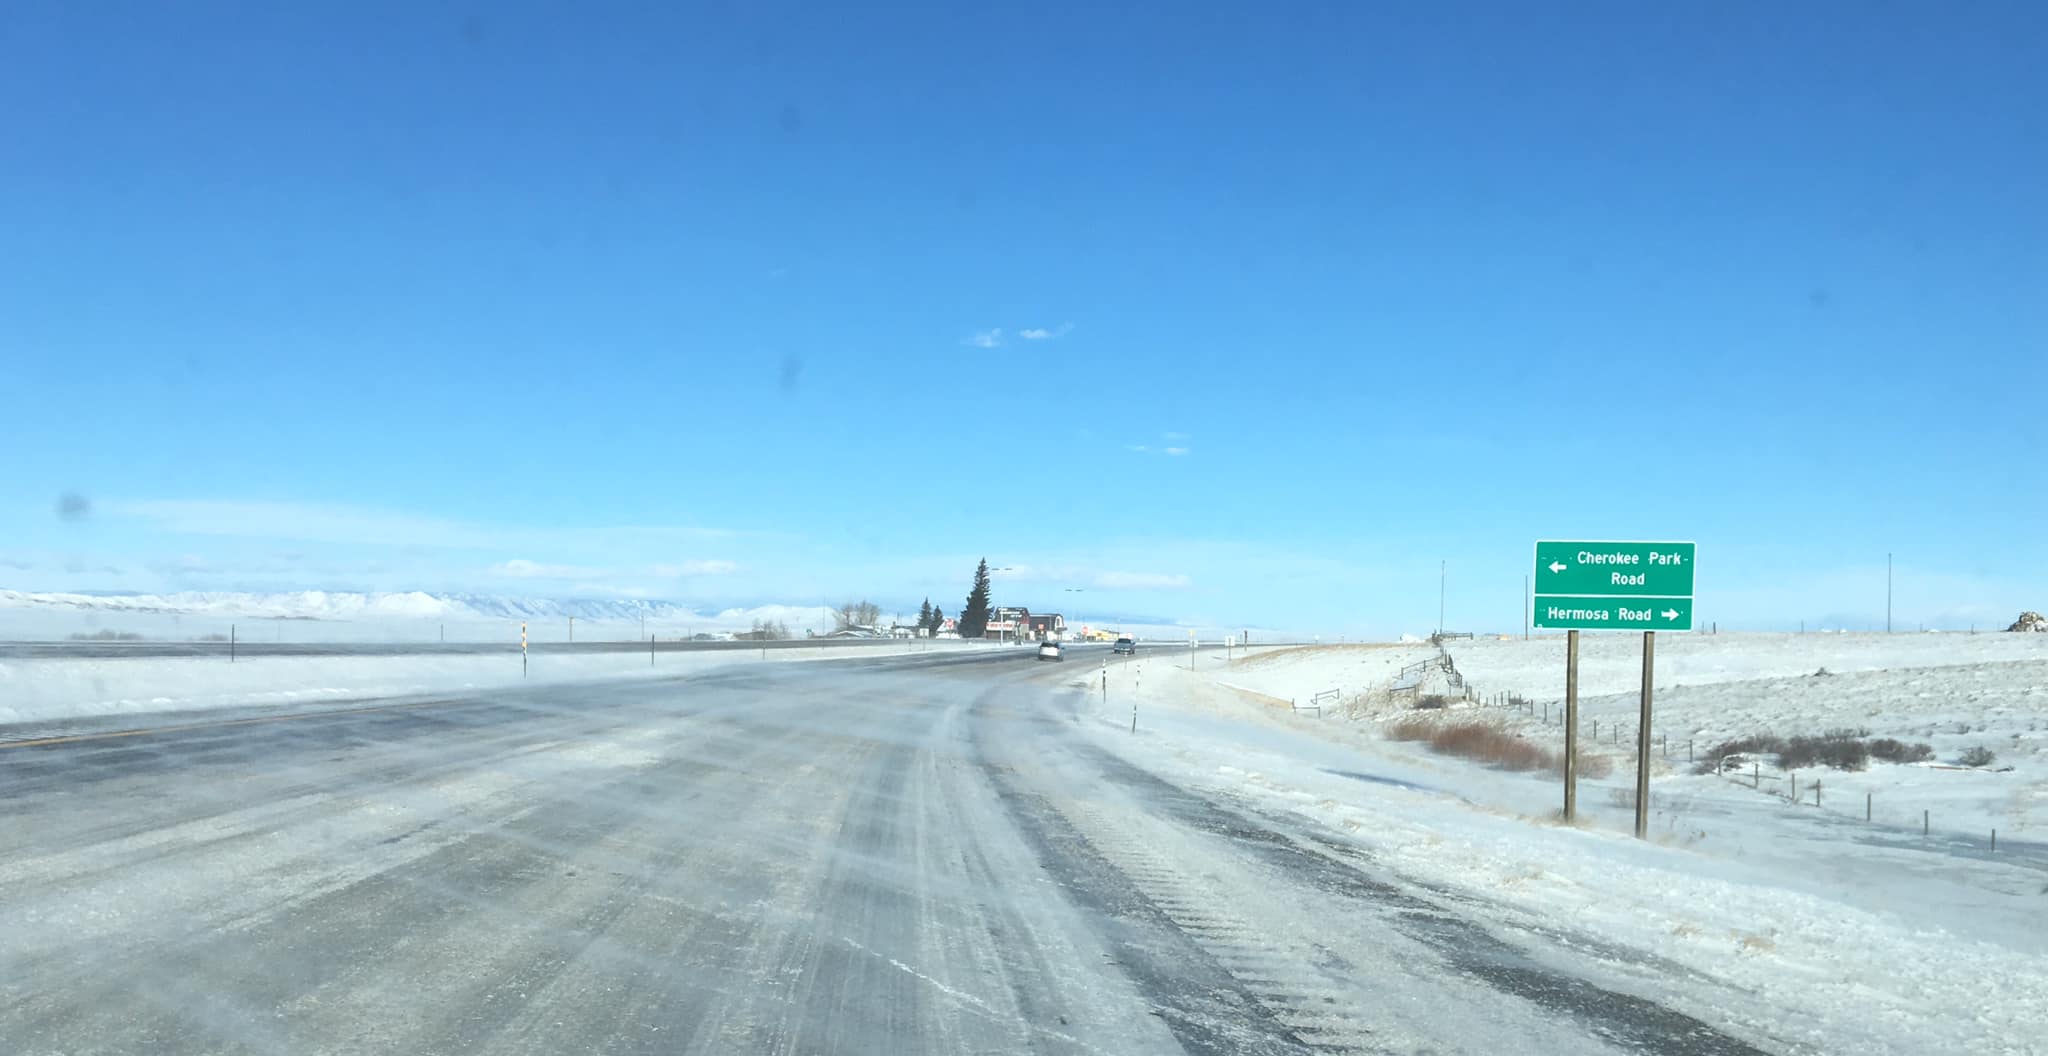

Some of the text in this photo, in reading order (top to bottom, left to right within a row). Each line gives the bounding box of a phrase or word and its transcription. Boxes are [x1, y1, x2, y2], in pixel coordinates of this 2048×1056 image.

[1577, 551, 1681, 565] Cherokee Park
[1611, 572, 1645, 585] Road
[1548, 607, 1652, 621] Hermosa Road
